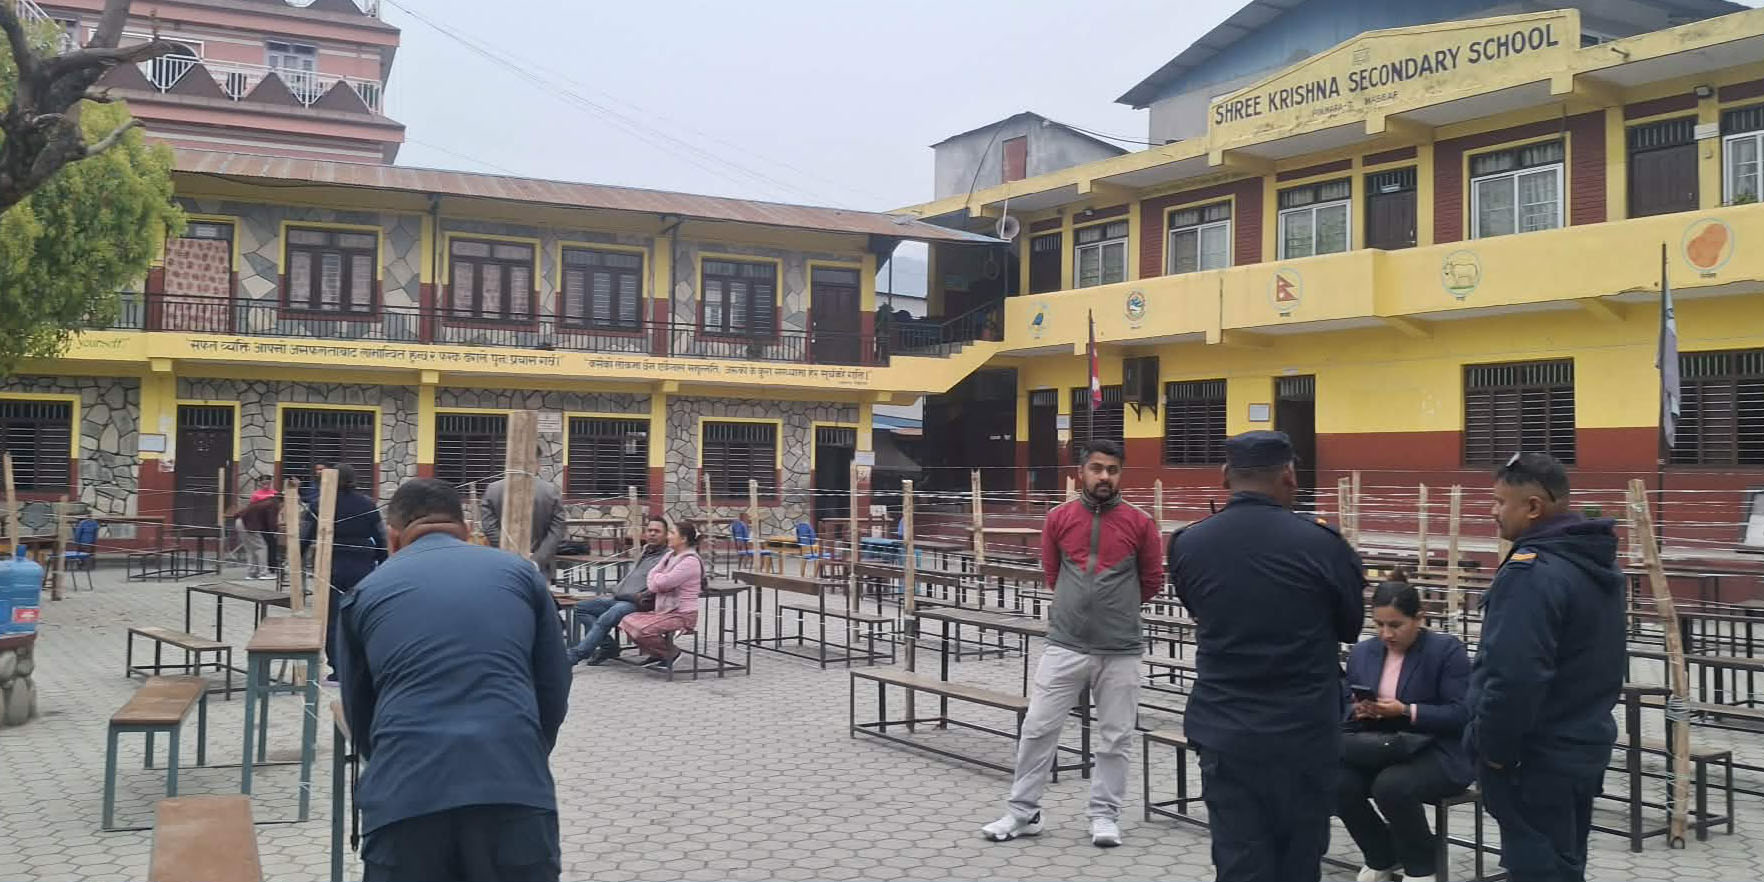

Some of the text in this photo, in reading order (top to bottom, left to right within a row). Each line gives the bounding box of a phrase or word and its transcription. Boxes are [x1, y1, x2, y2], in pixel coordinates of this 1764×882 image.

[1215, 24, 1559, 125] SHREE KRISHNA SECONDARY SCHOOL
